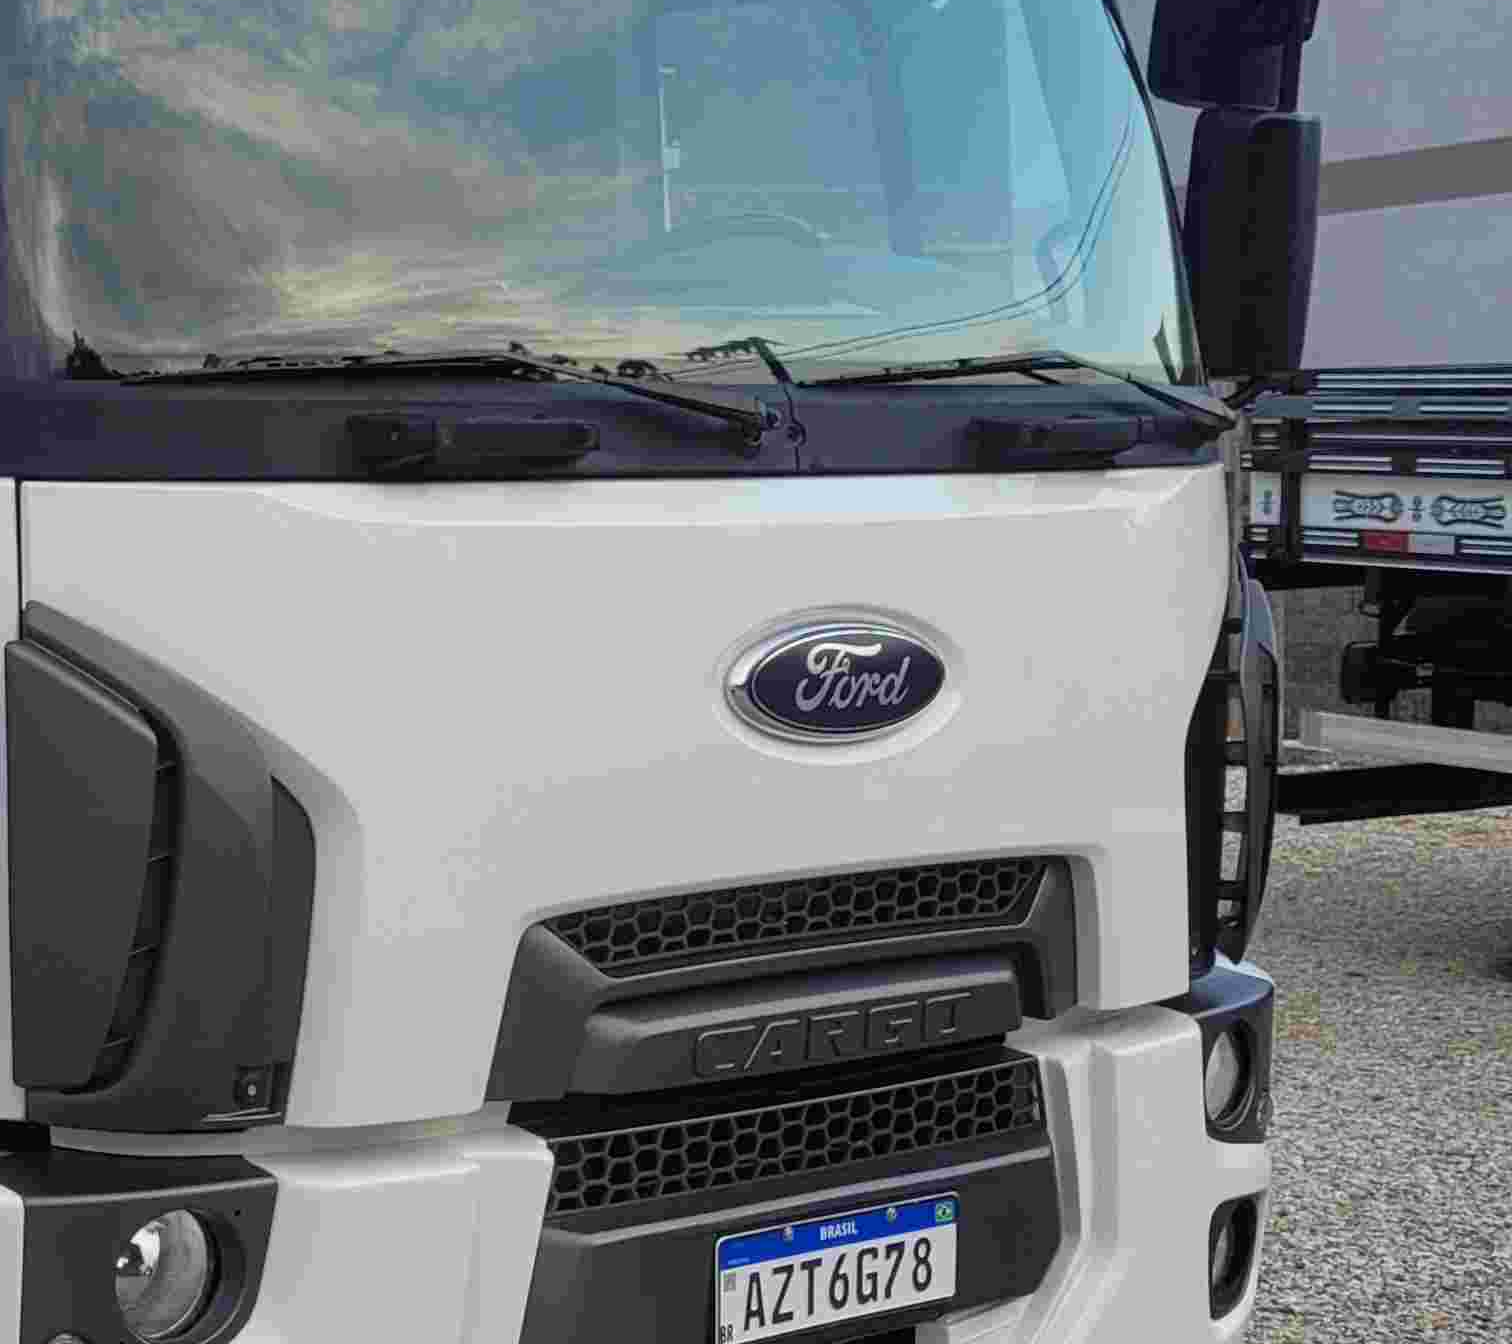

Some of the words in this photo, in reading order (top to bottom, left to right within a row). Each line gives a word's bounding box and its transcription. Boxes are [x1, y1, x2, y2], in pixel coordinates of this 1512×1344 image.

[795, 642, 911, 711] Ford
[694, 990, 974, 1078] CARGO
[819, 1220, 857, 1241] BRASIL
[743, 1237, 933, 1332] AZT6G78
[719, 1324, 735, 1344] BR
